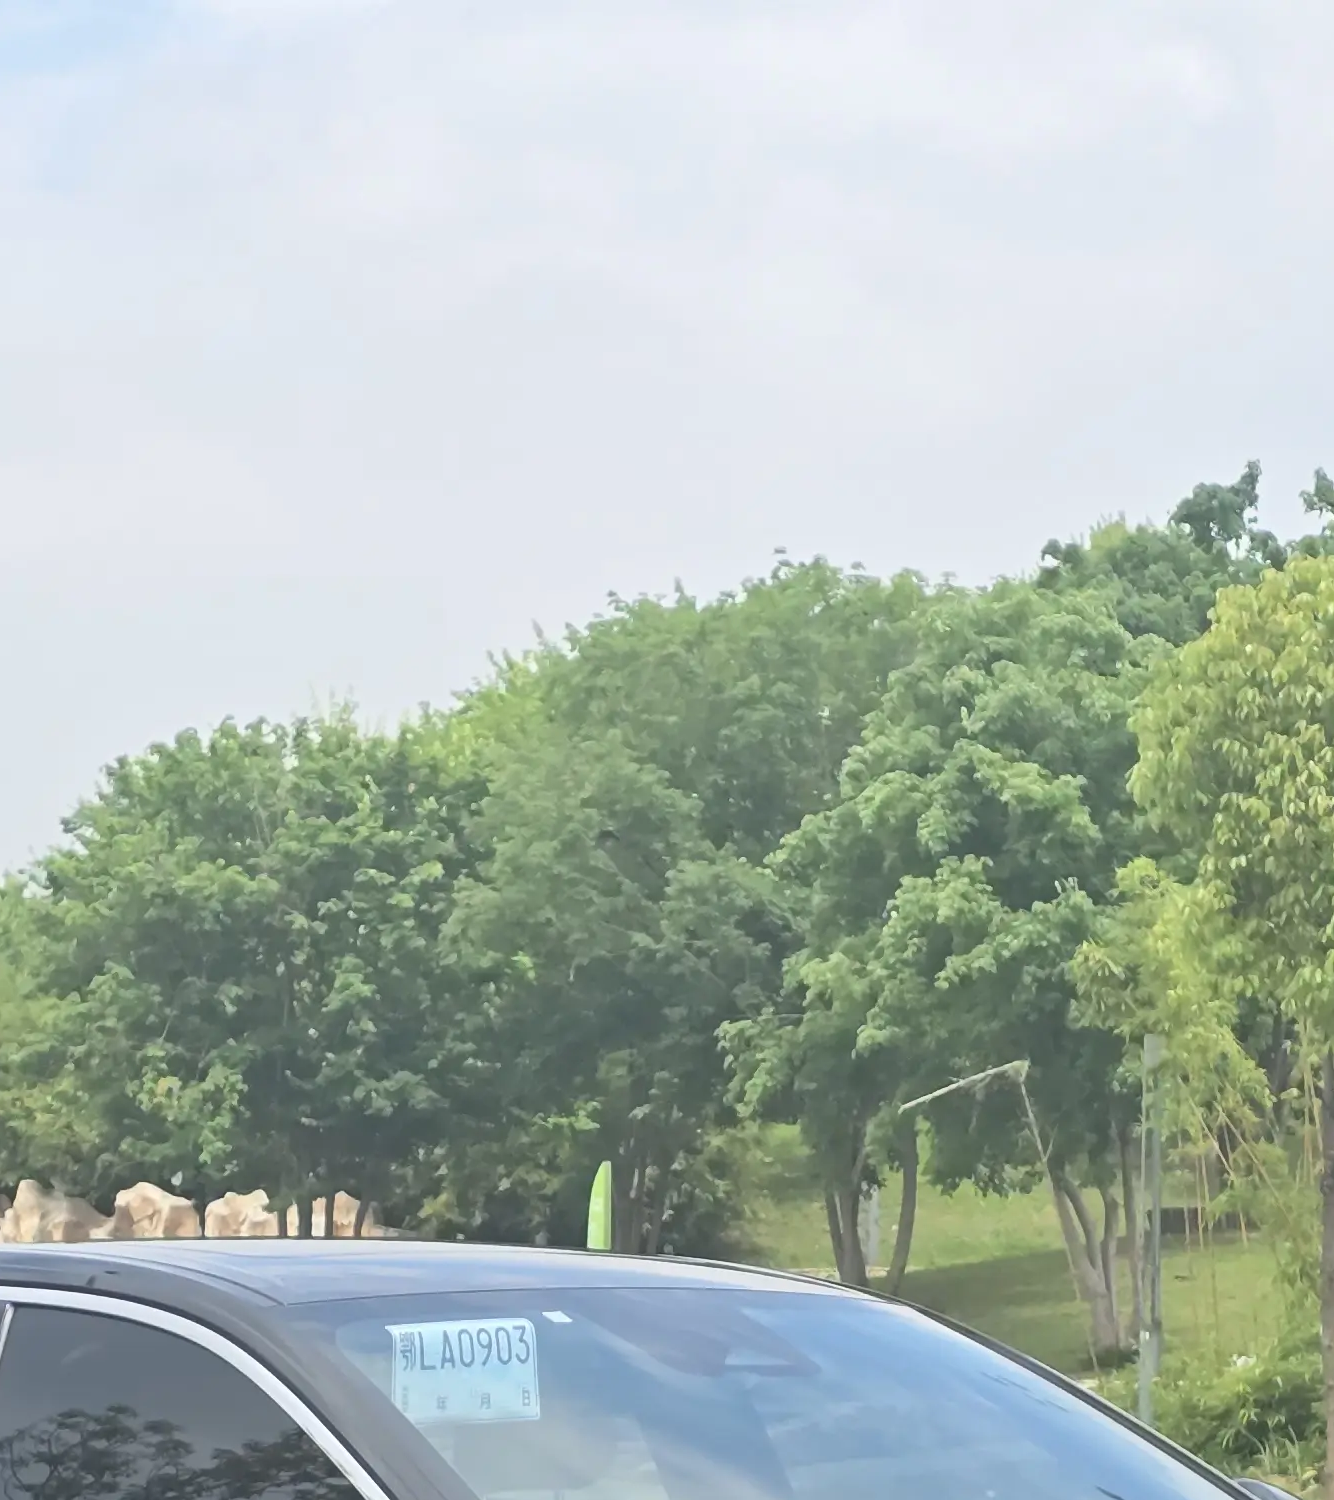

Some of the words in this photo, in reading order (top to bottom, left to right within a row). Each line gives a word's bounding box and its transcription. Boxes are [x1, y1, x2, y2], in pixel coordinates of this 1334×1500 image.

[399, 1325, 530, 1371] 鄂LA0903
[479, 1393, 491, 1410] 月
[522, 1389, 531, 1407] 日
